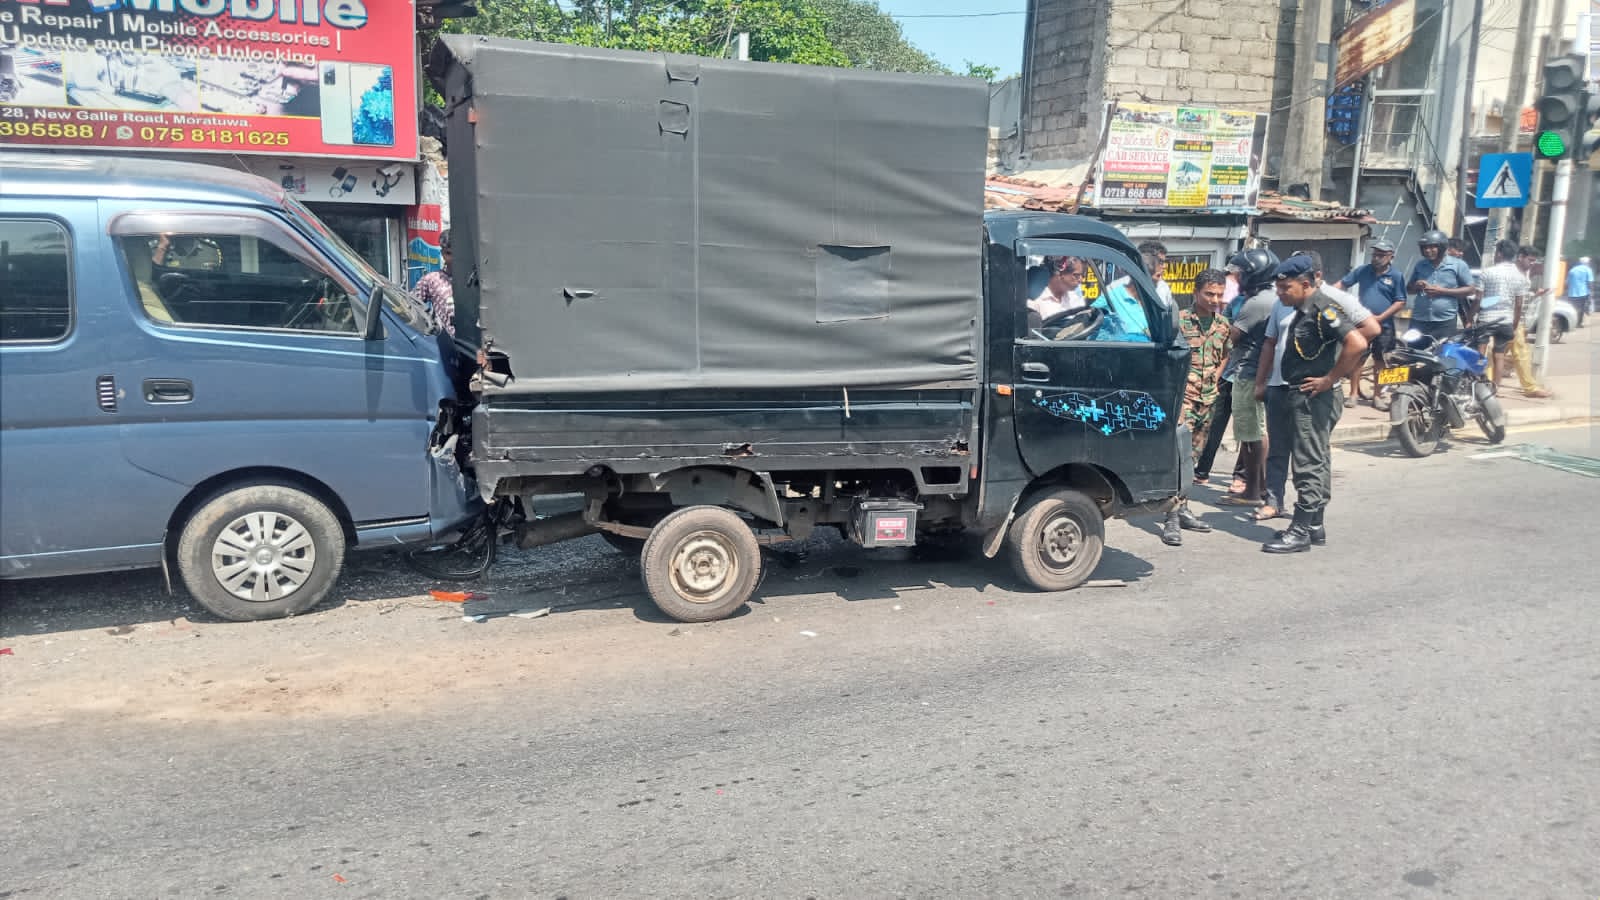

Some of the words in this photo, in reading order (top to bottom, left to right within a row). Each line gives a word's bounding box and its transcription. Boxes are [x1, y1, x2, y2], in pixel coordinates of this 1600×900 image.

[21, 5, 103, 31] Repair
[122, 13, 198, 37] Mobile
[203, 21, 330, 47] Accessories
[121, 0, 368, 30] obile
[0, 24, 88, 50] Update
[94, 38, 134, 51] and
[141, 34, 211, 58] Phone
[216, 44, 317, 68] Unlocking
[2, 107, 29, 120] 28,
[34, 108, 72, 120] New
[76, 110, 118, 122] Galle
[122, 112, 169, 125] Road,
[173, 115, 253, 127] Moratuwa.
[0, 121, 94, 138] 395588
[140, 127, 185, 142] 075
[191, 128, 290, 146] 8181625
[1129, 151, 1169, 162] SERVICE
[1104, 187, 1126, 198] 0719
[1128, 188, 1145, 199] 668
[1147, 188, 1165, 199] 668
